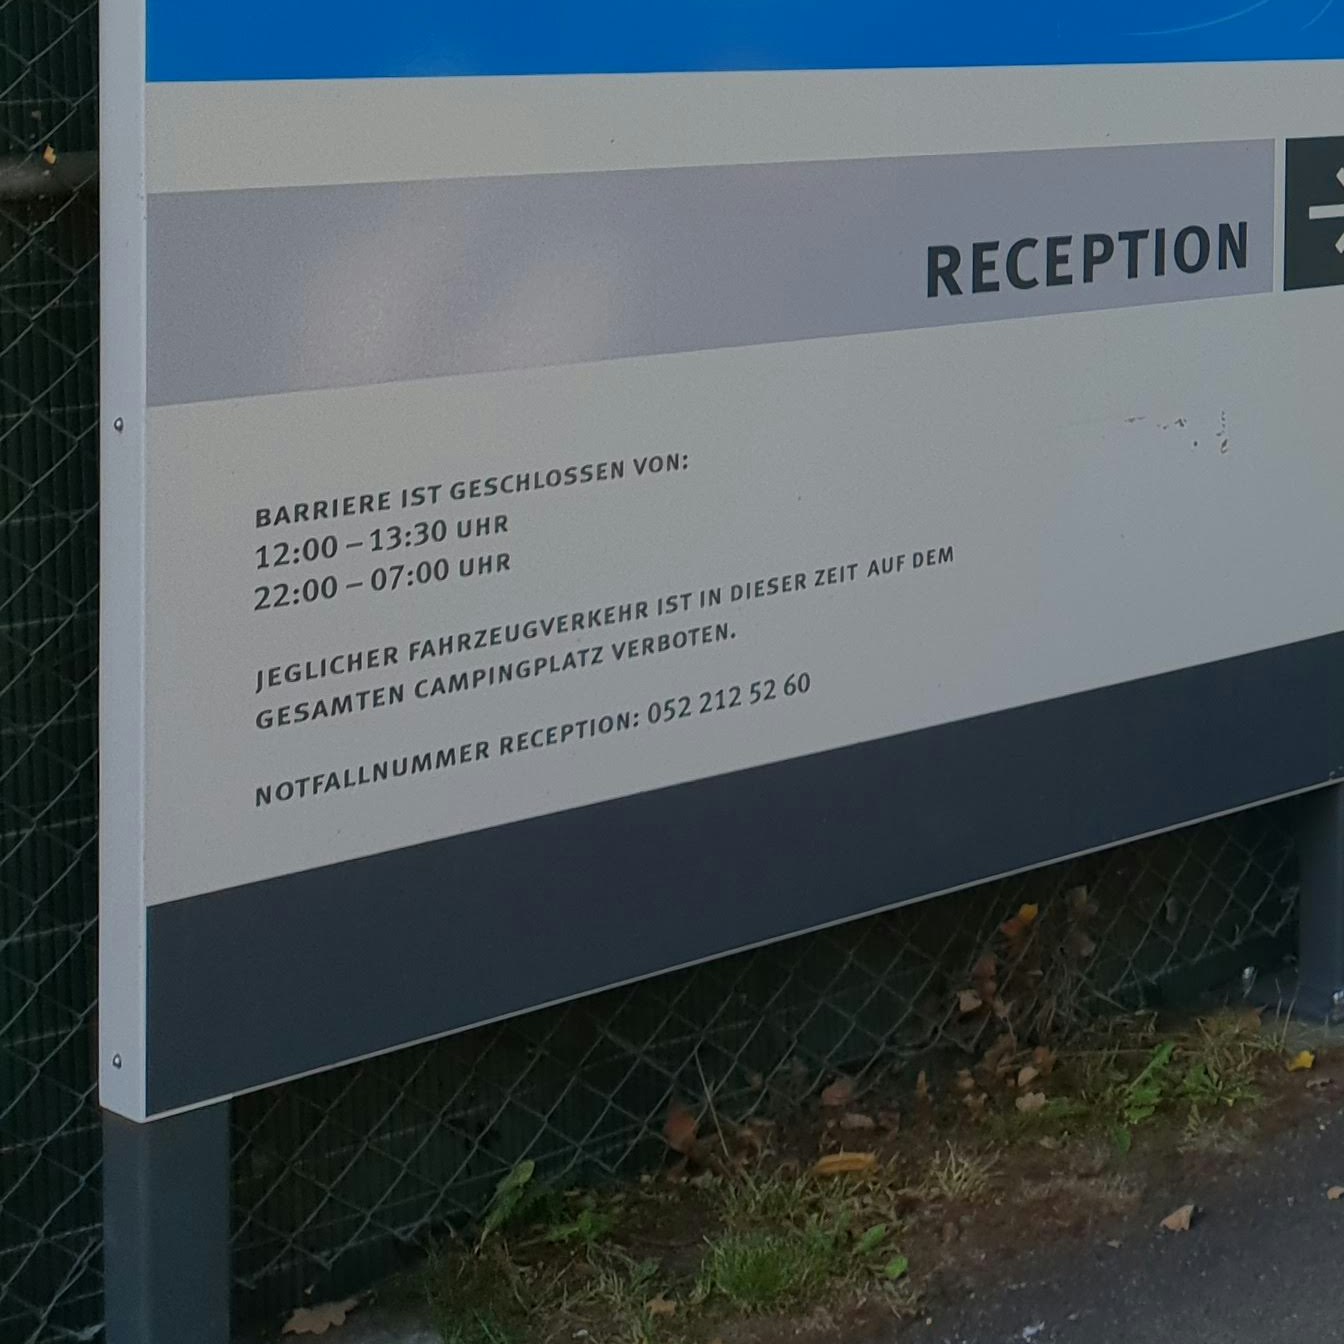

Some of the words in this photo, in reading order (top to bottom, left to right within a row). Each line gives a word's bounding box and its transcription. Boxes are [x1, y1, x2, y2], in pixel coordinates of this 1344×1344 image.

[927, 221, 1249, 298] RECEPTION
[255, 491, 391, 529] BARRIERE
[401, 484, 443, 509] IST
[449, 460, 624, 501] GESCHLOSSEN
[632, 453, 688, 476] VON:
[456, 514, 508, 539] UHR
[459, 552, 511, 578] UHR
[255, 646, 399, 695] JEGLICHER
[409, 601, 649, 662] FAHRZEUGVERKEHR
[657, 592, 693, 616] IST
[700, 587, 721, 609] IN
[730, 572, 807, 603] DIESER
[814, 563, 859, 587] ZEIT
[866, 554, 906, 578] AUF
[912, 545, 954, 569] DEM
[255, 683, 404, 730] GESAMTEN
[414, 645, 604, 699] CAMPINGPLATZ
[611, 622, 736, 661] VERBOTEN.
[255, 741, 490, 808] NOTFALLNUMMER
[500, 711, 639, 756] RECEPTION:
[647, 695, 692, 724] 052
[699, 685, 742, 714] 212
[749, 678, 777, 705] 52
[783, 672, 811, 696] 60
